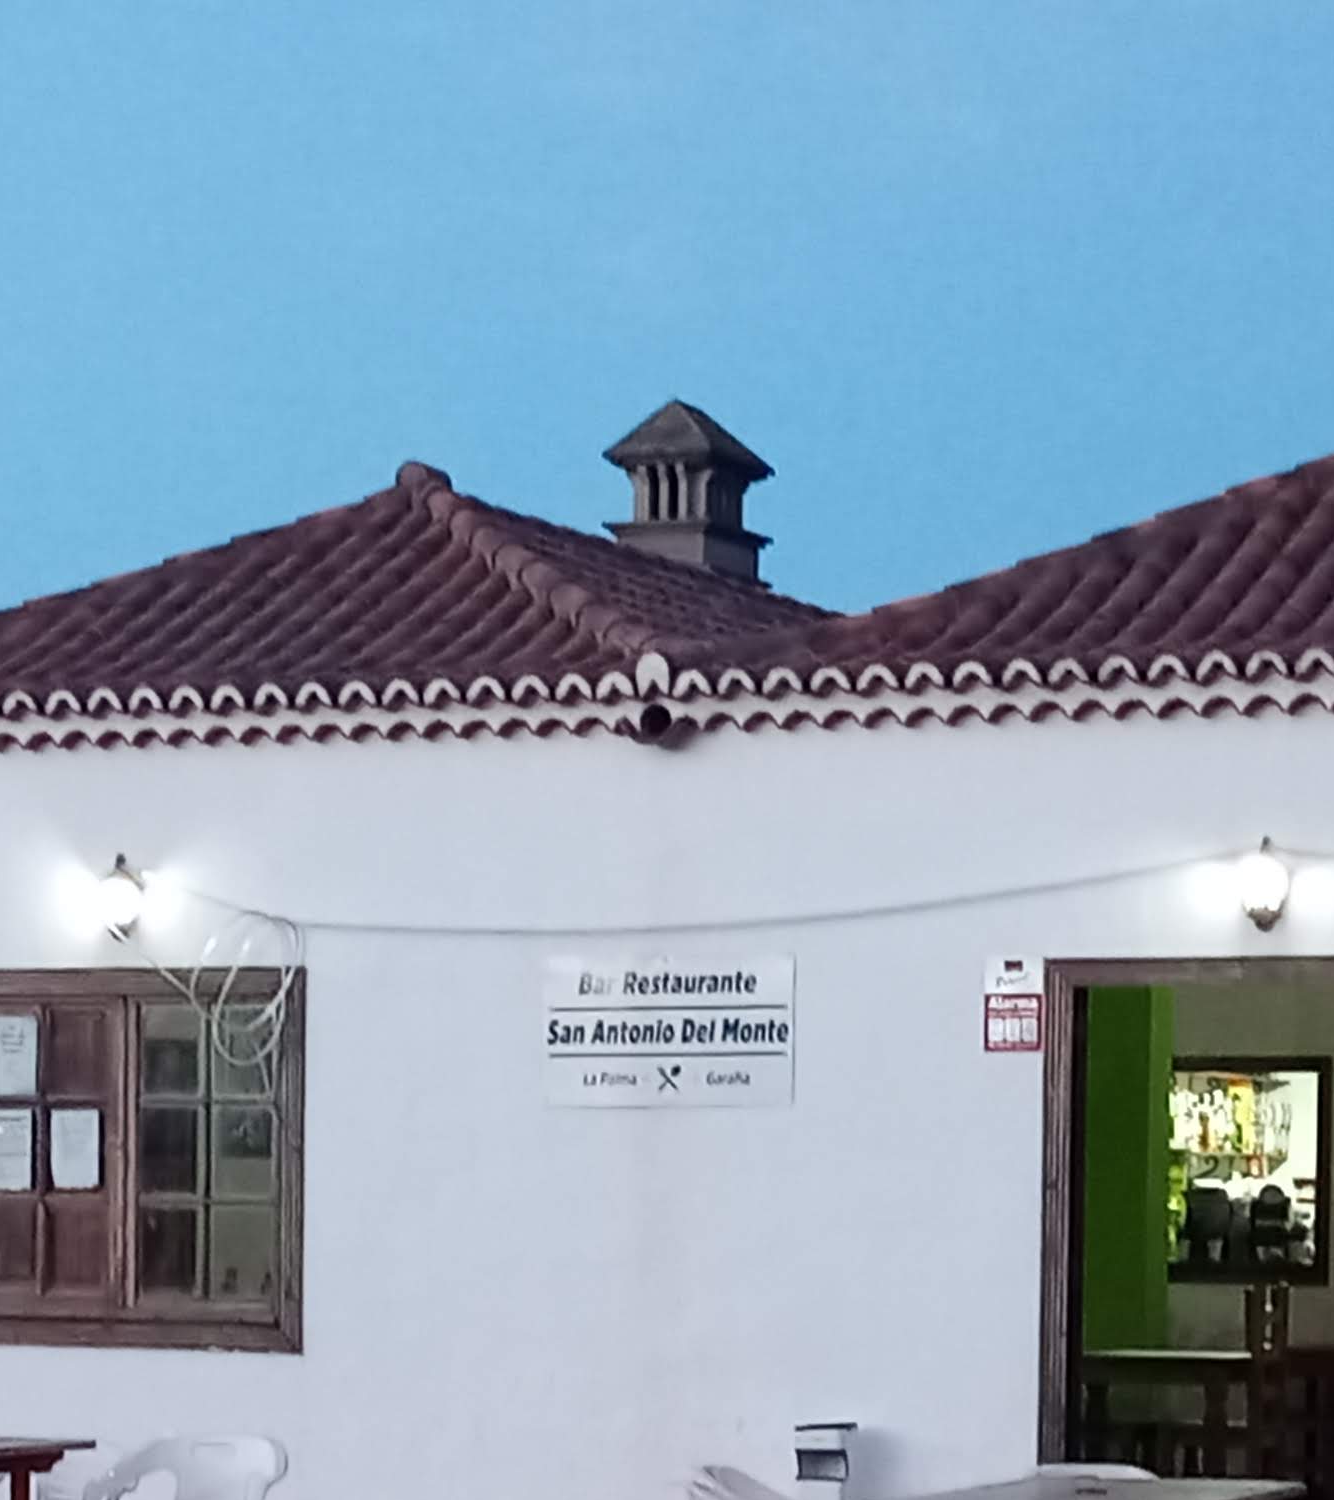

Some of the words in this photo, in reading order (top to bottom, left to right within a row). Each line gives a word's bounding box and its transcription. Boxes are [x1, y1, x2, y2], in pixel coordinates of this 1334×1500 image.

[578, 972, 614, 995] Bar
[623, 971, 757, 995] Restaurante
[547, 1019, 585, 1045] San
[590, 1018, 675, 1044] Antonio
[681, 1017, 716, 1044] Del
[721, 1017, 789, 1043] Monte
[583, 1072, 597, 1087] La
